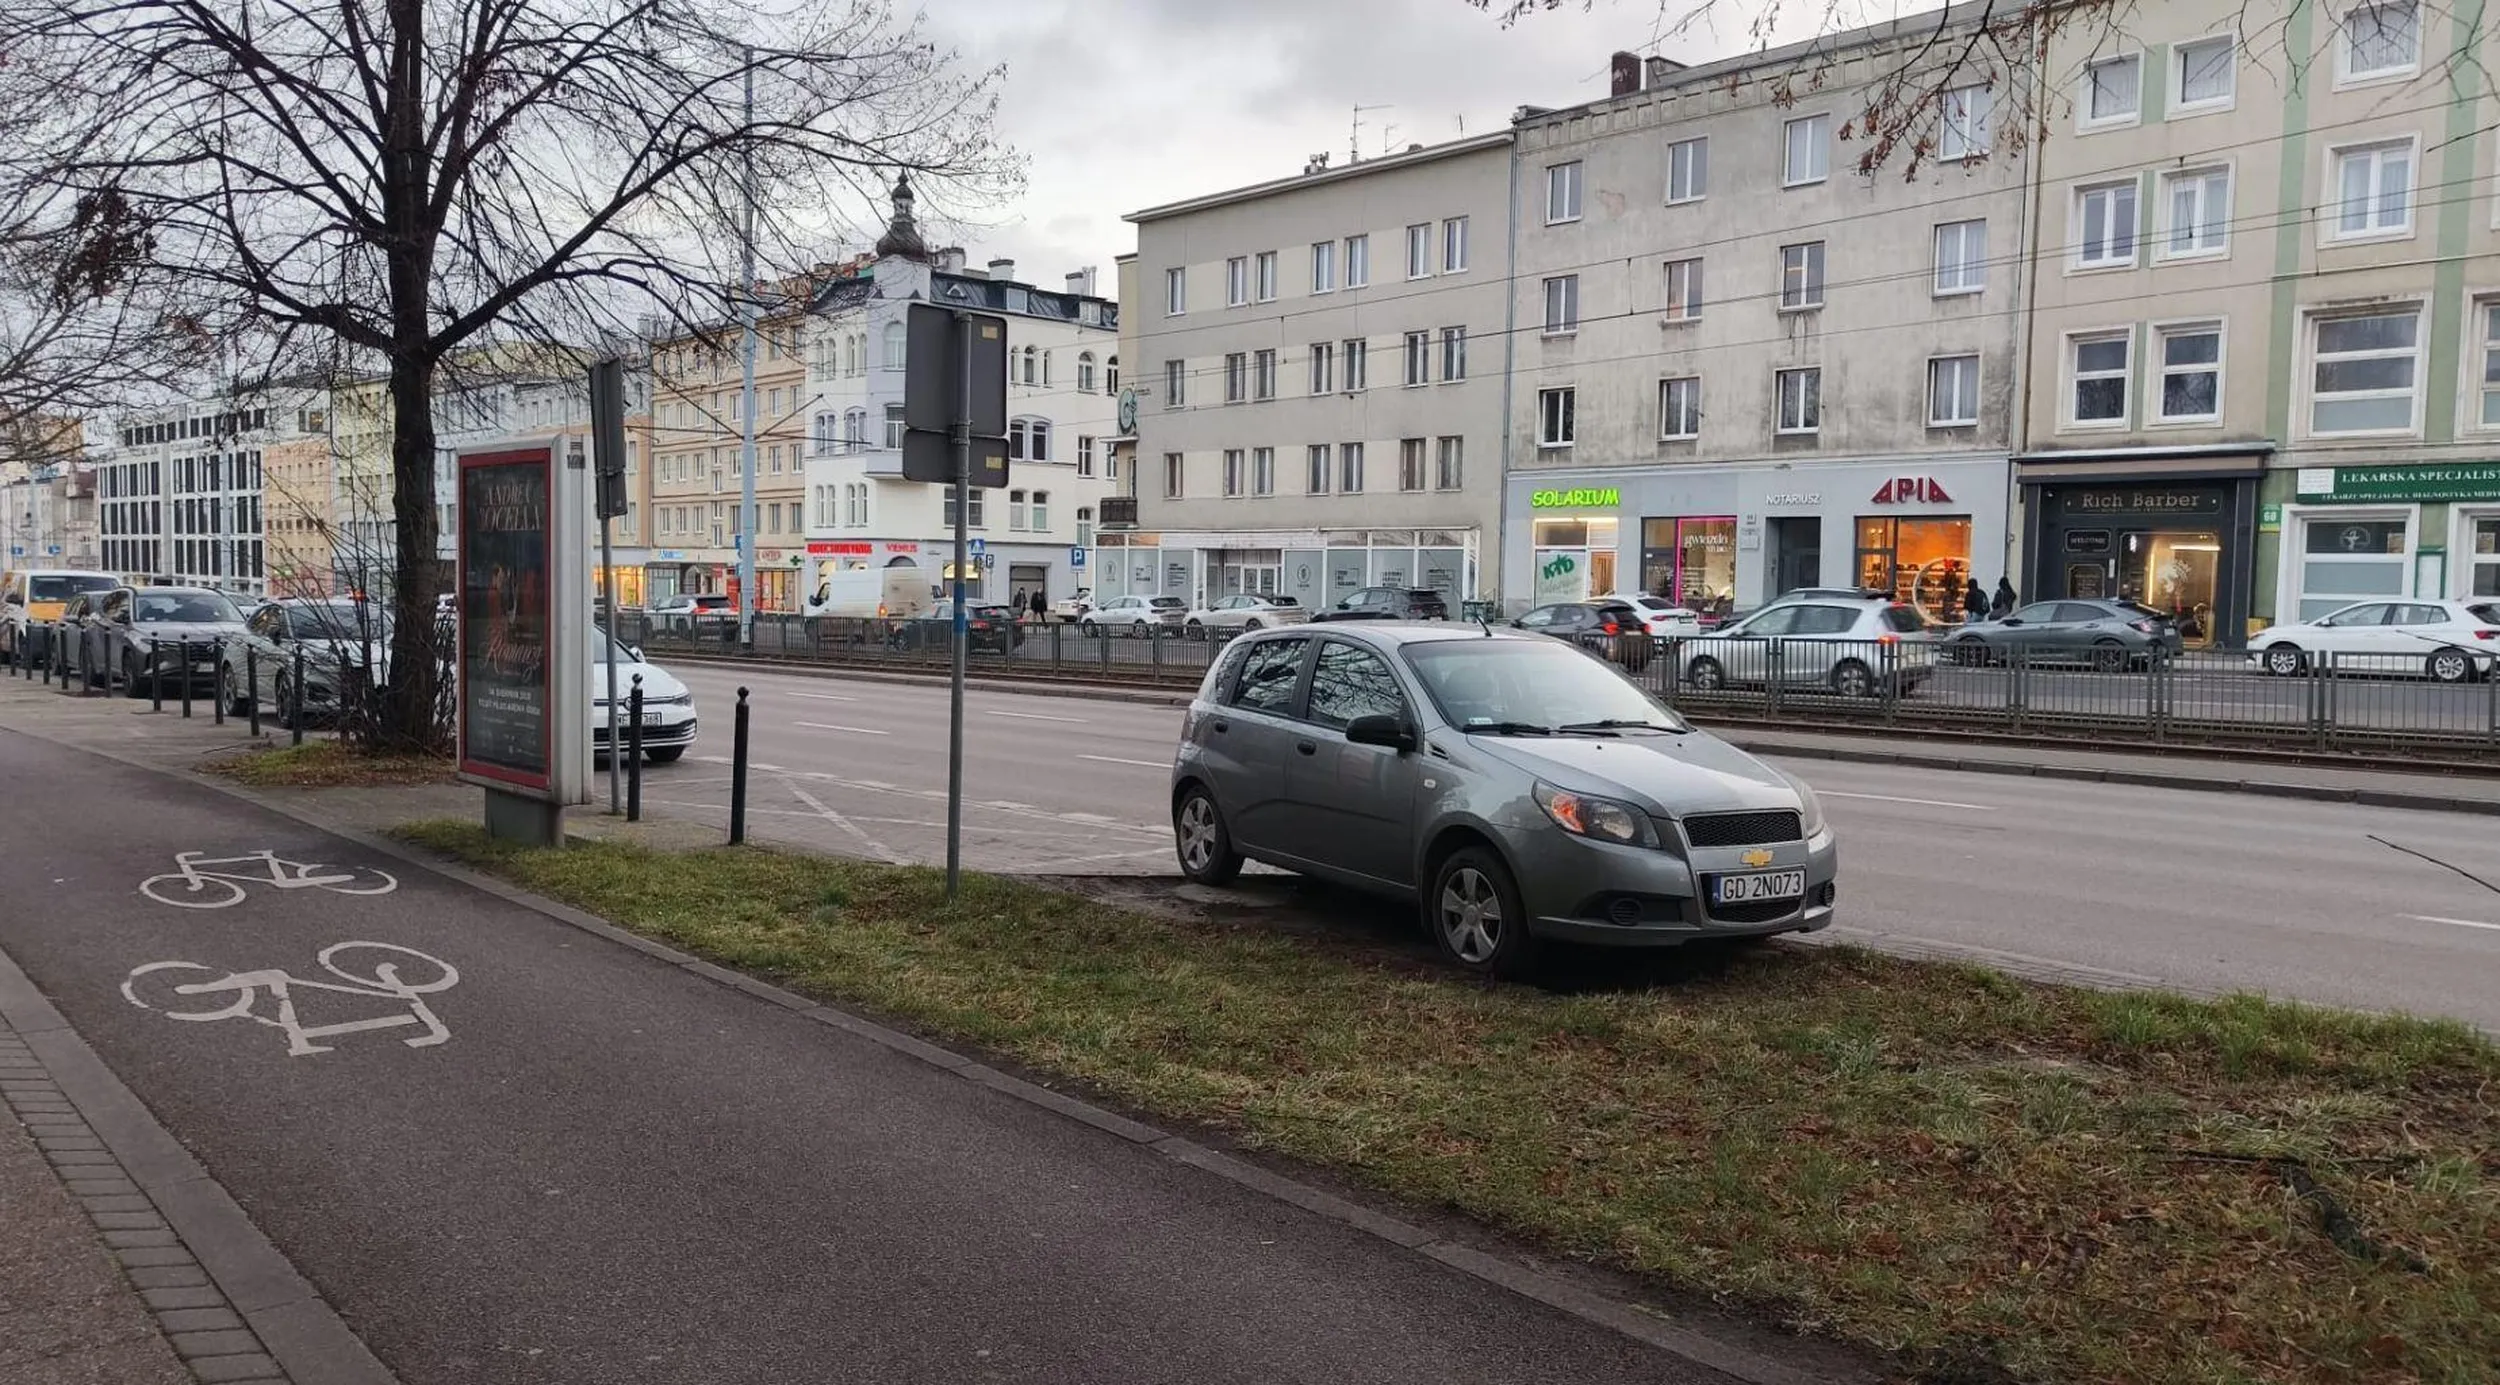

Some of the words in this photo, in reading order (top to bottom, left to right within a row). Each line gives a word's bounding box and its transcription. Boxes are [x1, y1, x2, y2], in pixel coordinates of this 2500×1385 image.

[2342, 472, 2415, 483] LEKARSKA
[1870, 476, 1953, 503] APIA
[1532, 488, 1620, 508] SOLARIUM
[1766, 493, 1822, 505] NOTARIUSZ
[2082, 492, 2123, 508] Rich
[2133, 492, 2200, 507] Barber
[1074, 550, 1083, 564] P
[1723, 878, 1746, 900] GD
[1752, 872, 1802, 897] 2N073
